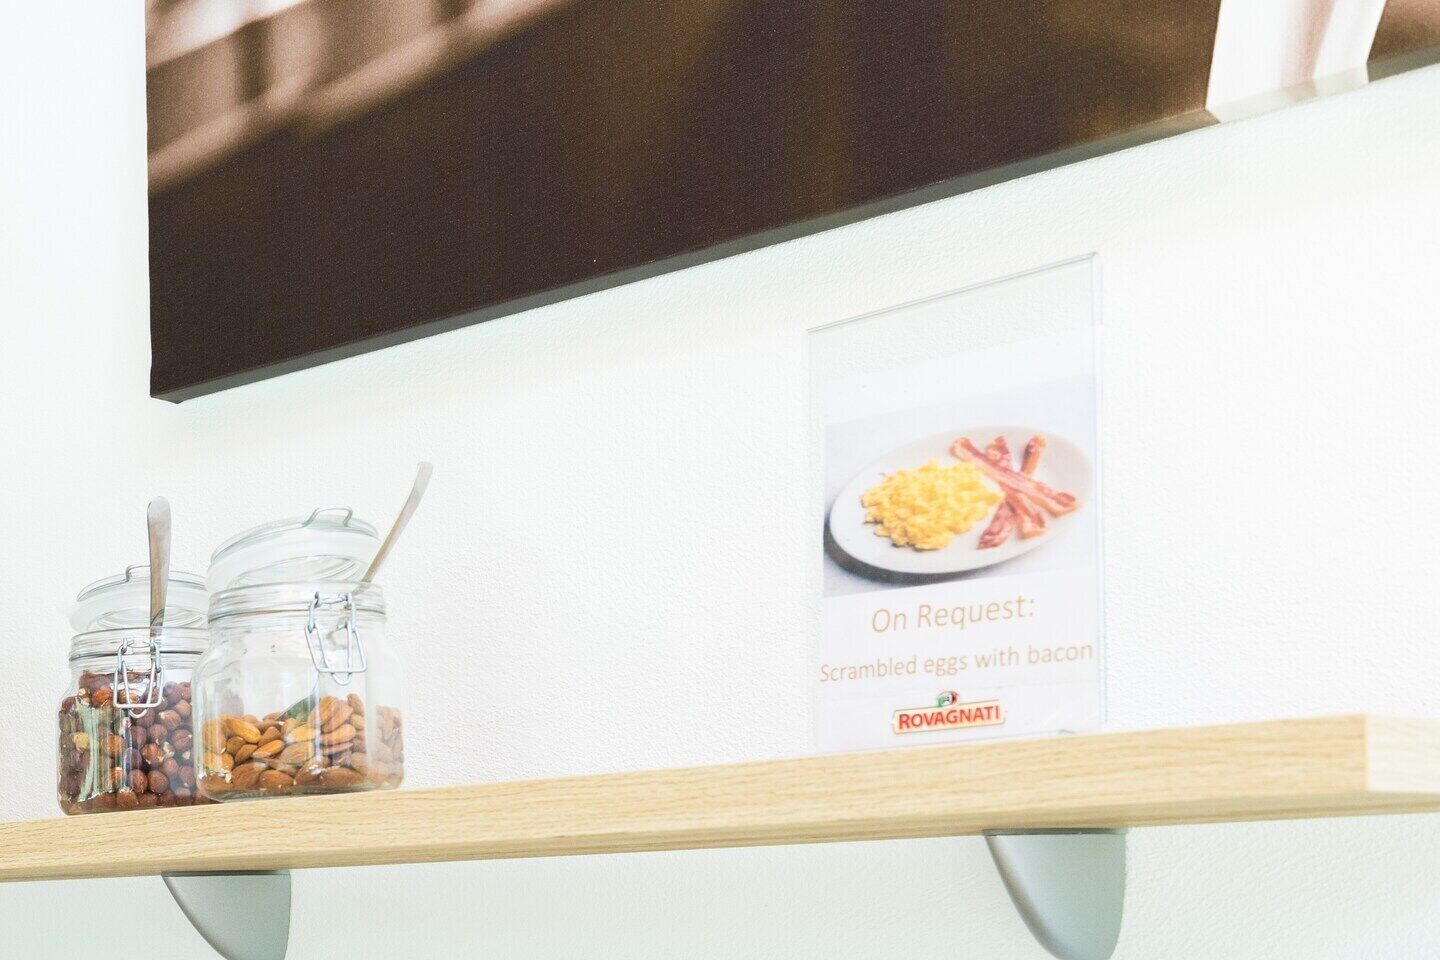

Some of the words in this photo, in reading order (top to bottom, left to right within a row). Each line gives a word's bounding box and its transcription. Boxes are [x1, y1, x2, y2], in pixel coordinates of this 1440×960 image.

[871, 608, 907, 634] On
[917, 595, 1035, 630] Request:
[820, 655, 917, 683] Scrambled
[923, 653, 968, 676] eggs
[974, 646, 1020, 669] with
[1027, 643, 1093, 665] bacon
[898, 705, 1000, 730] ROVAGNATI
